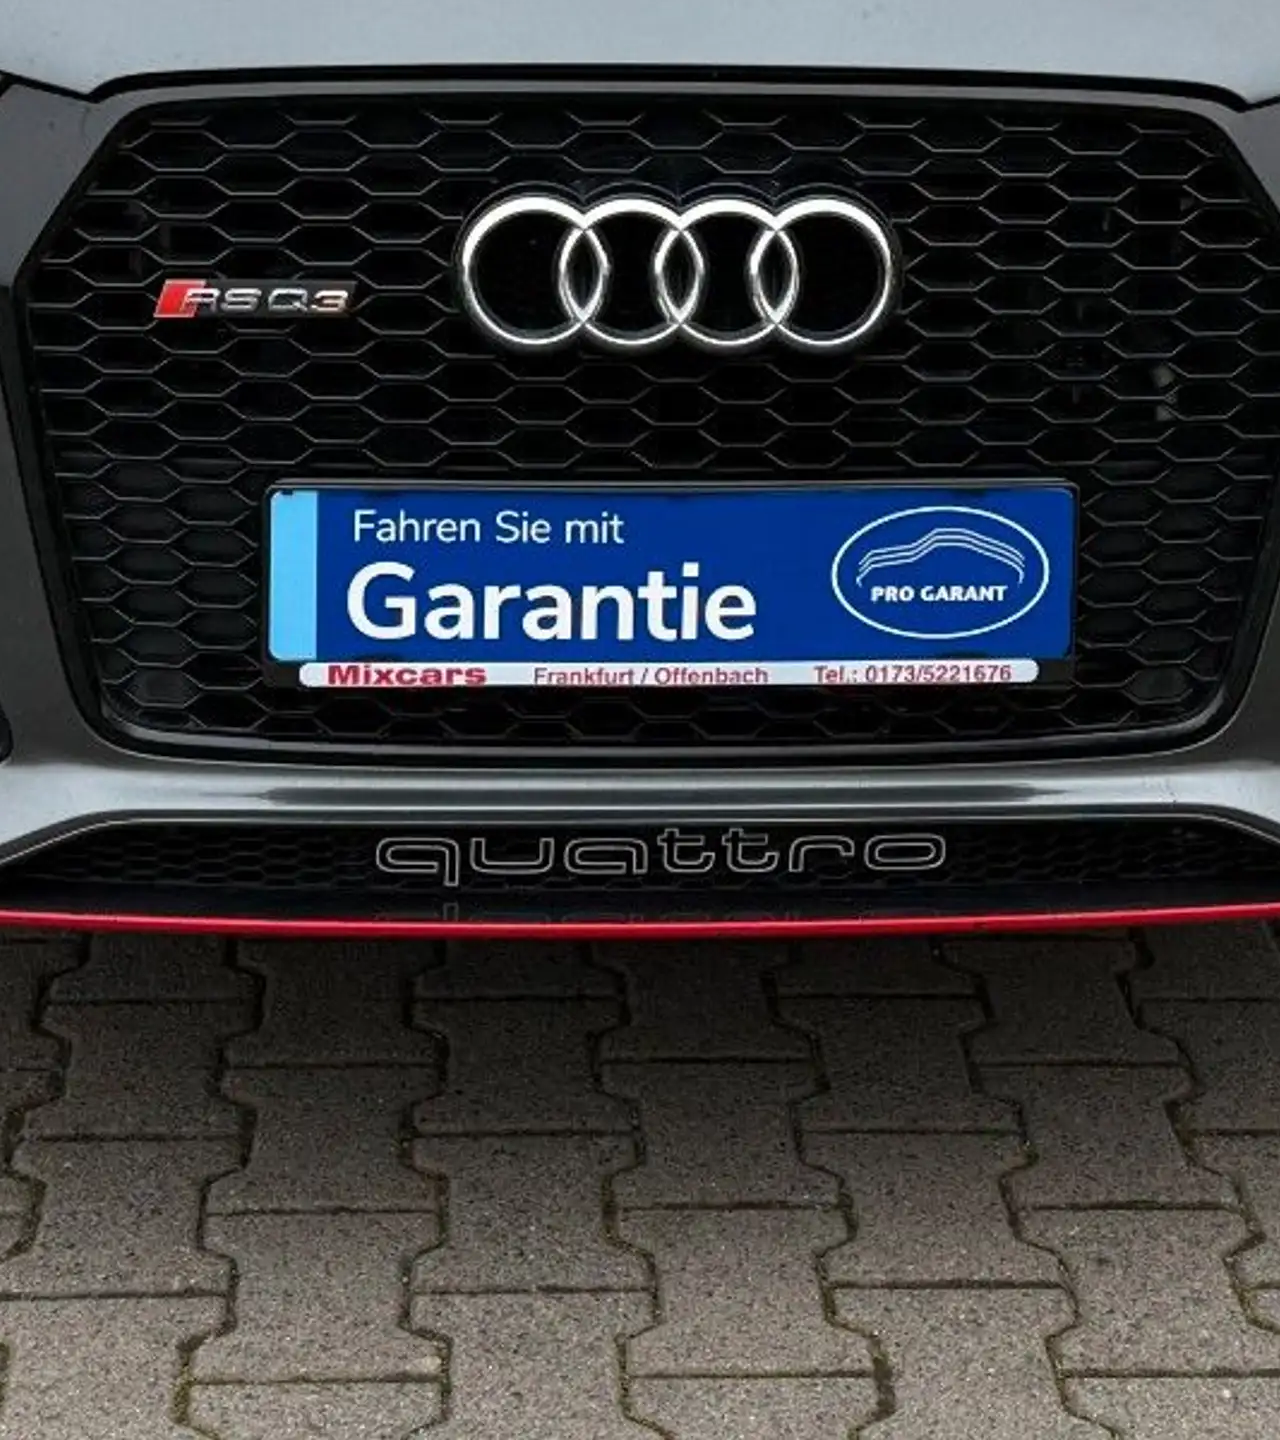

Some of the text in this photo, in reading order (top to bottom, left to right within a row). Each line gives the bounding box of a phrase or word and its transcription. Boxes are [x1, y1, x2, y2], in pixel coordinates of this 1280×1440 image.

[352, 509, 625, 544] Fahren Sie mit
[346, 560, 758, 642] Garantie
[870, 585, 1009, 602] PRO GARANT
[327, 664, 488, 686] Mixcars
[533, 666, 634, 686] Frankfurt
[654, 667, 768, 685] Offenbach
[864, 664, 1012, 683] 0173/5221676
[375, 827, 946, 888] quattro
